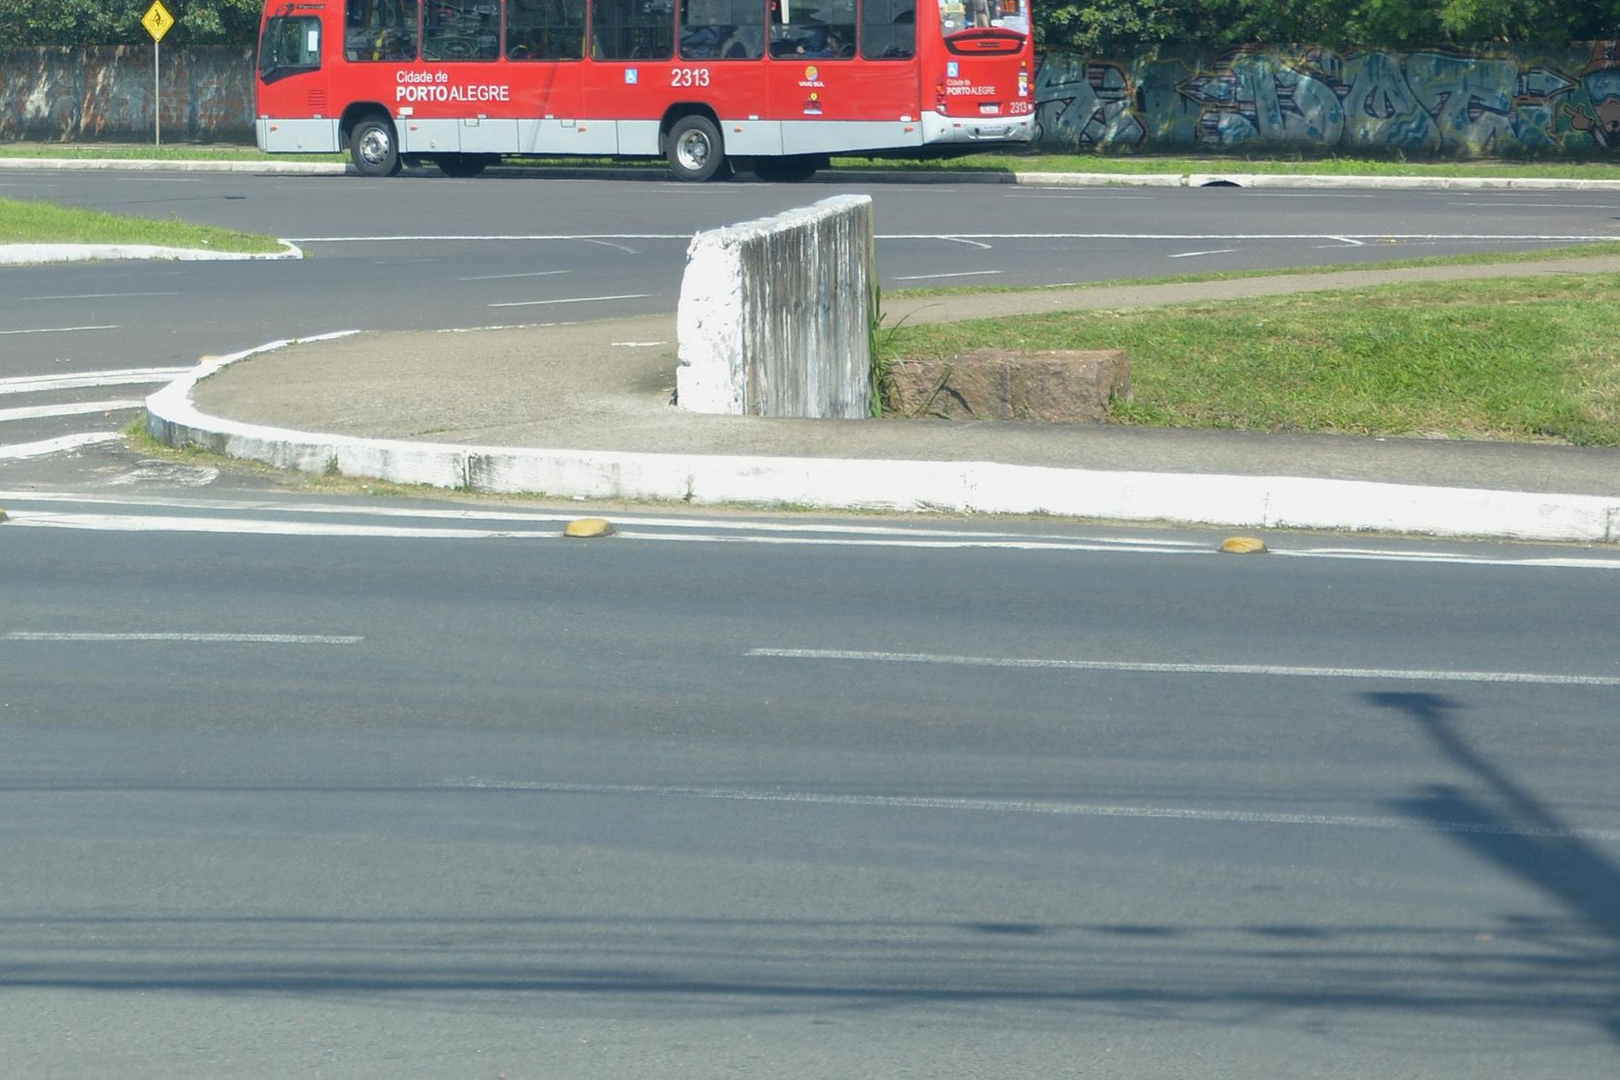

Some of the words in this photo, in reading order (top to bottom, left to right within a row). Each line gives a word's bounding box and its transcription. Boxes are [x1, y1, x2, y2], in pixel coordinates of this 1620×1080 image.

[396, 70, 433, 83] Cidade
[435, 70, 448, 83] de
[671, 68, 710, 87] 2313
[396, 86, 448, 101] PORTO
[449, 86, 510, 101] ALEGRE
[947, 86, 971, 95] PORTO
[971, 86, 996, 95] ALEGRE
[1010, 101, 1027, 114] 2313
